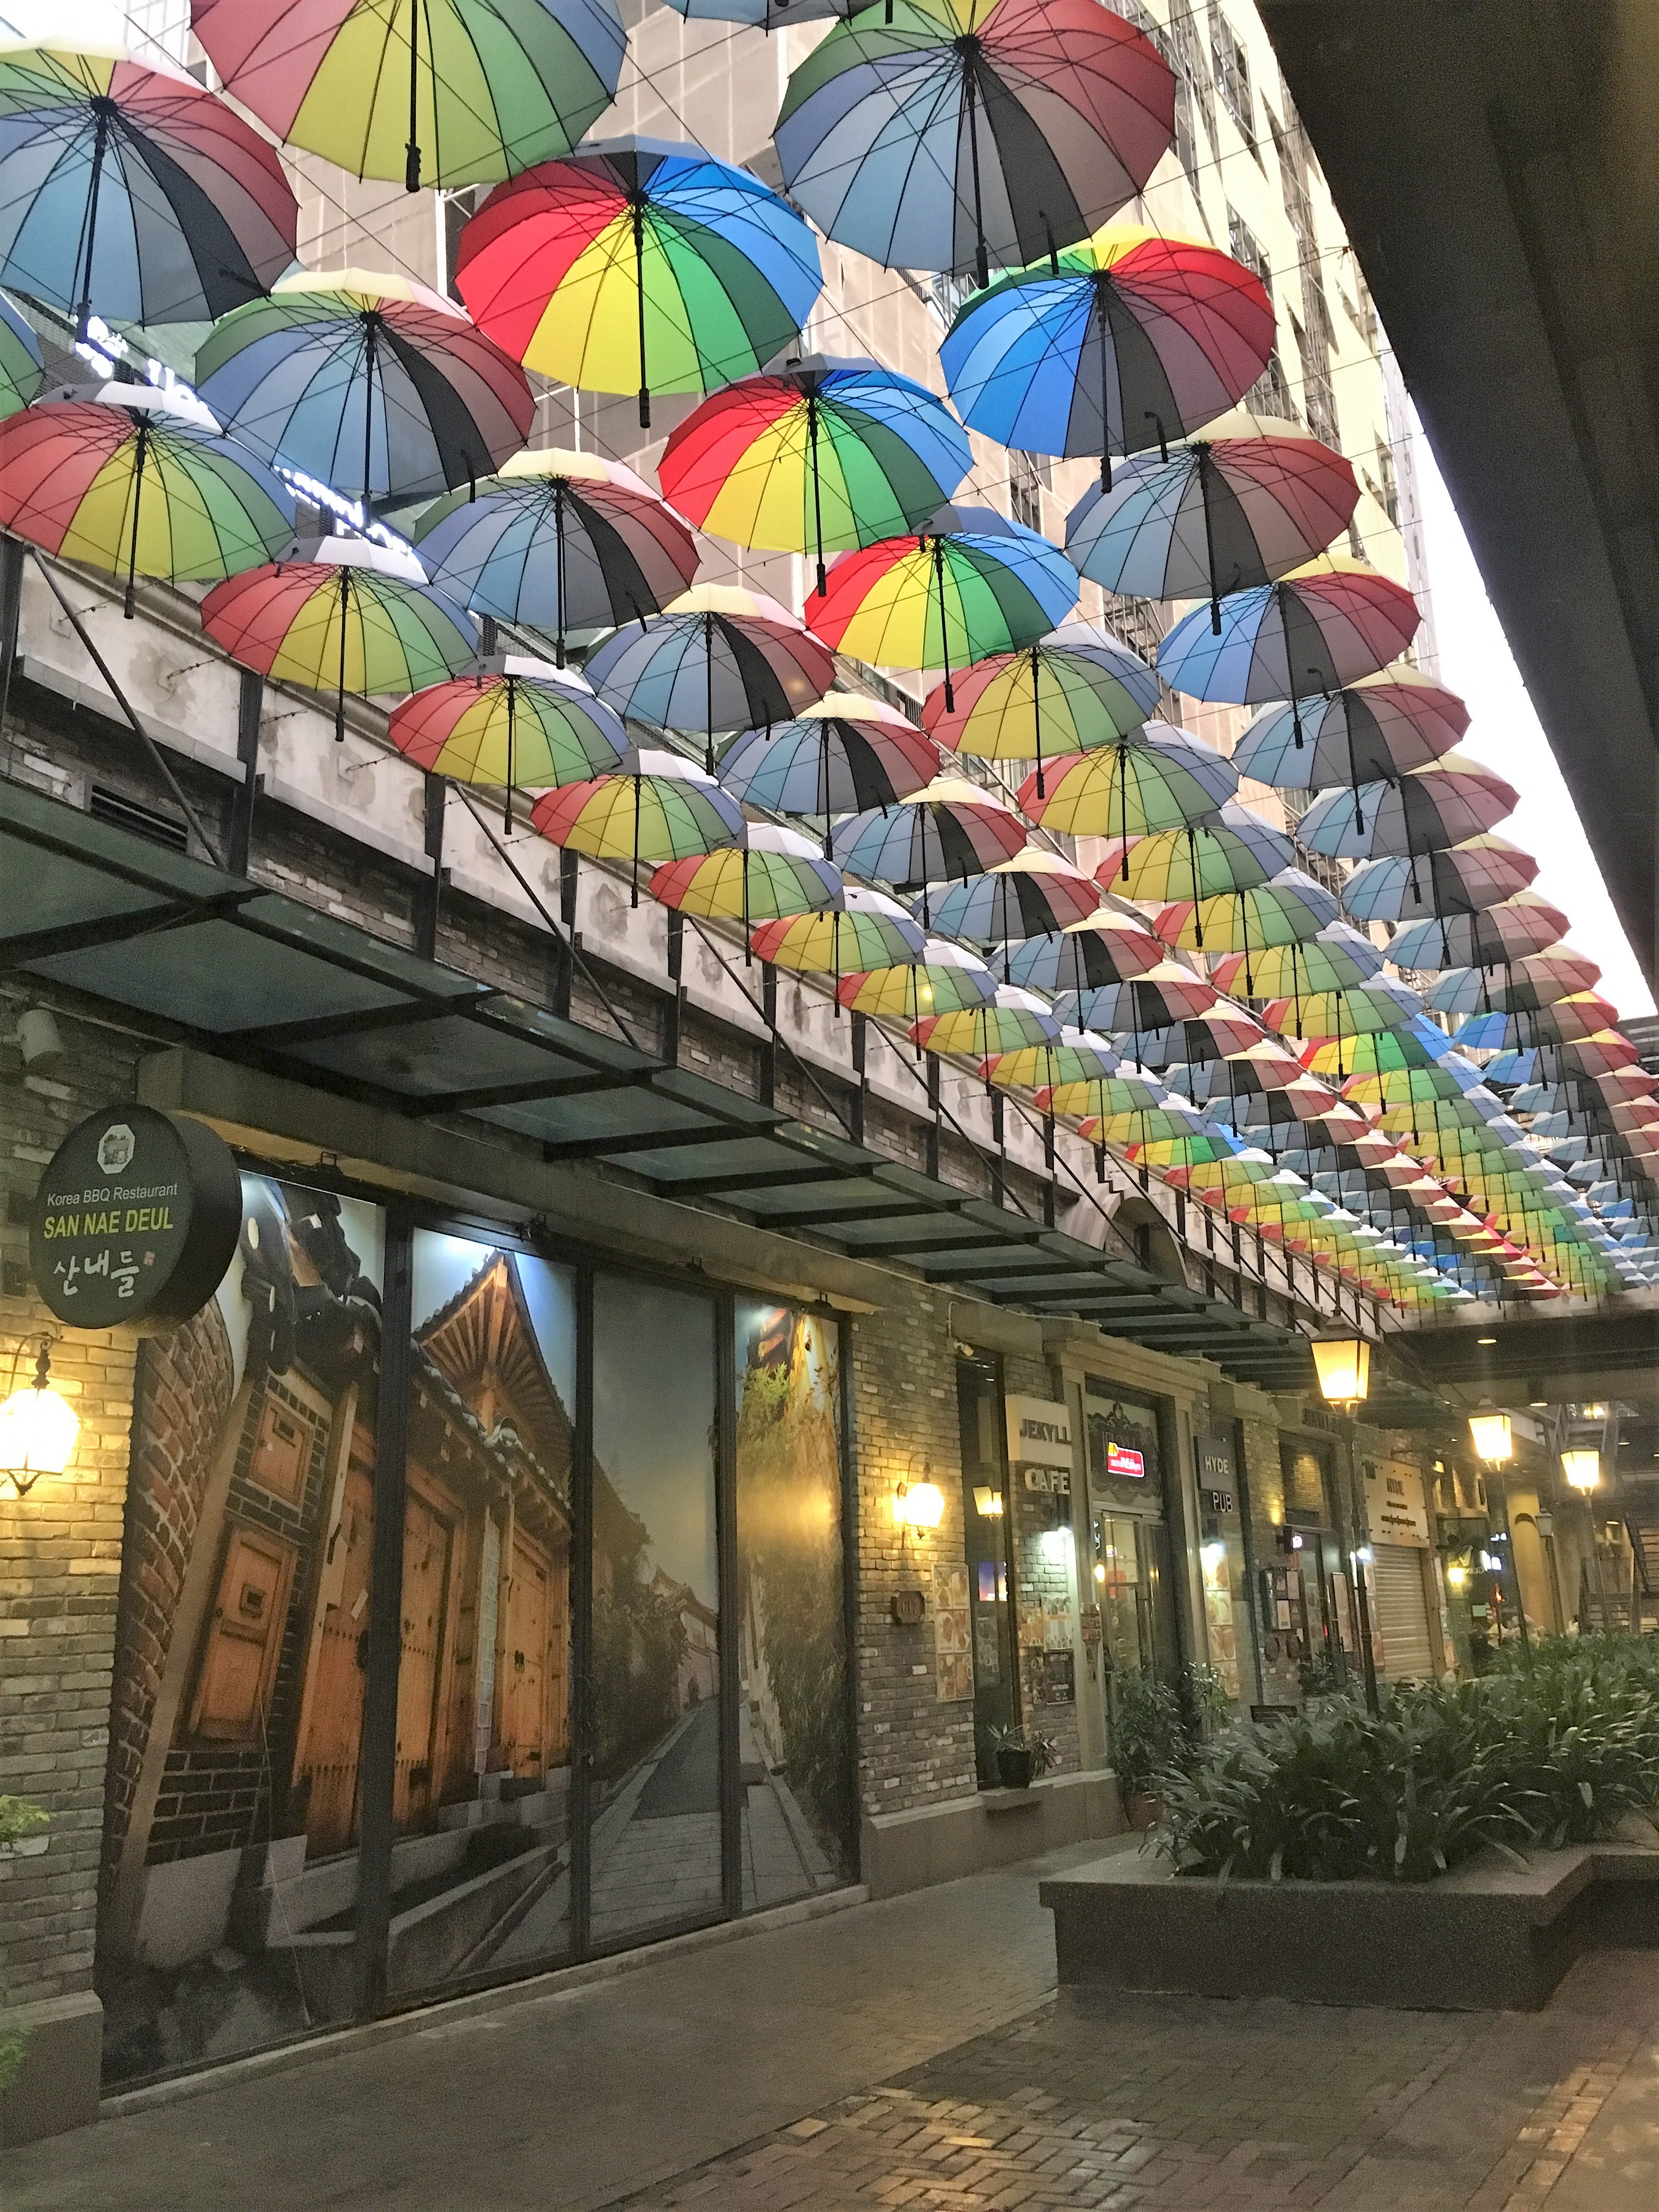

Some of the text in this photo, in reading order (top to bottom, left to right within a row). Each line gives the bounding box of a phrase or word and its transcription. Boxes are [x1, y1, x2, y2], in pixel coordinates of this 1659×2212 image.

[47, 1183, 178, 1206] Korea BBQ Restaurant
[43, 1207, 173, 1239] SAN NAE DEUL
[53, 1249, 140, 1298] 산내들
[1020, 1418, 1072, 1445] JEKYLL
[1205, 1455, 1229, 1474] HYDE
[1025, 1468, 1070, 1494] CAFE
[1212, 1492, 1233, 1512] PUB
